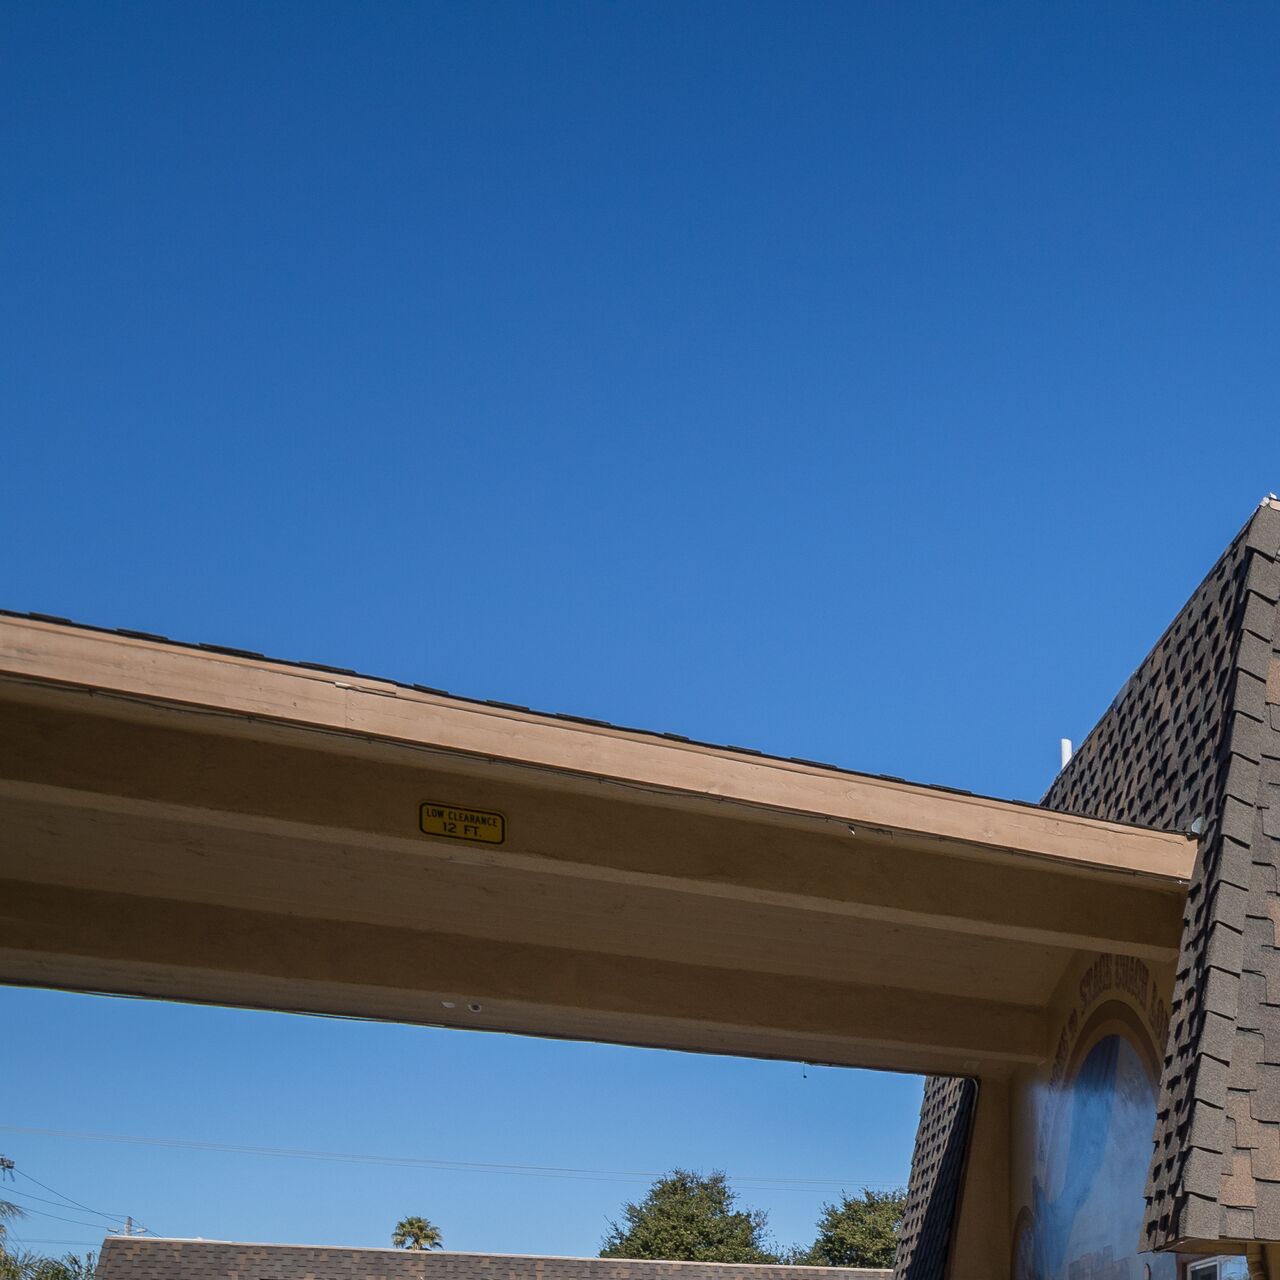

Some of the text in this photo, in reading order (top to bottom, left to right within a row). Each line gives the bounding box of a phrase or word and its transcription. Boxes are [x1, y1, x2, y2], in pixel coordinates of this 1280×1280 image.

[426, 808, 498, 828] LOW CLEARANCE
[442, 822, 483, 838] 12 FT.
